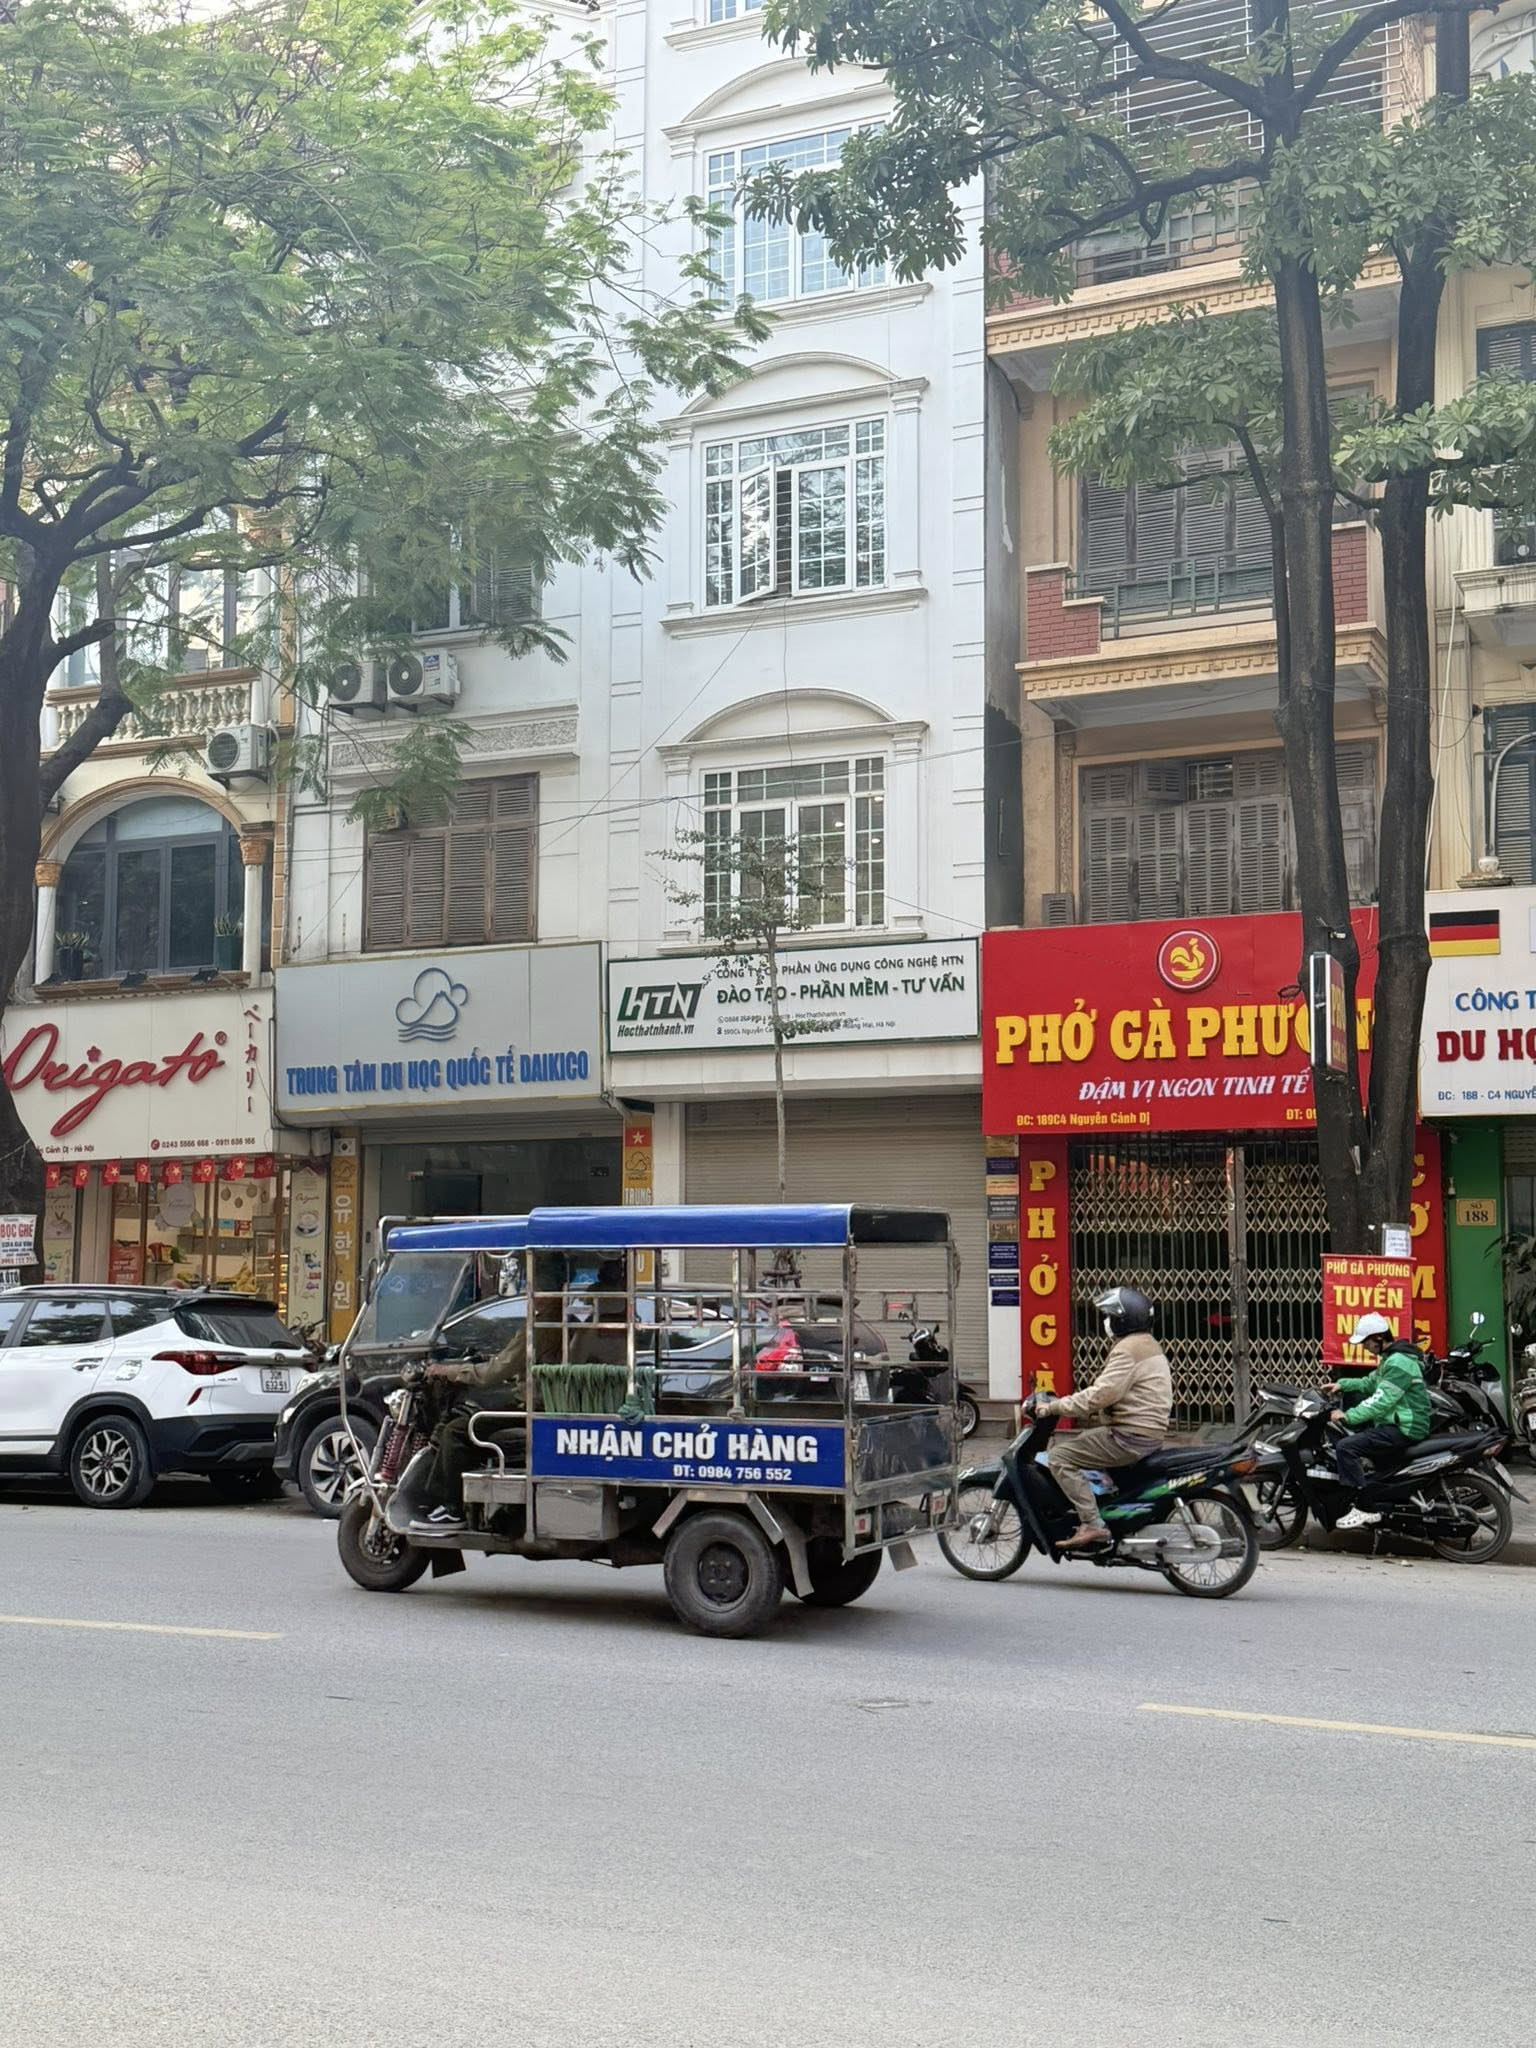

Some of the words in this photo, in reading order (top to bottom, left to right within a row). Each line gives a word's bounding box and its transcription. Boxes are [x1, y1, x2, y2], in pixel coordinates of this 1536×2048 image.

[717, 967, 745, 978] CÔNG
[782, 961, 811, 975] PHẦN
[814, 960, 837, 973] ỨNG
[840, 959, 871, 972] DỤNG
[874, 957, 904, 970] CÔNG
[907, 955, 938, 969] NGHỆ
[941, 955, 964, 966] HTN
[717, 984, 752, 1004] ĐÀO
[754, 986, 787, 1004] TẠO
[800, 979, 845, 999] PHẦN
[849, 976, 889, 997] MỀM
[901, 977, 926, 994] TƯ
[930, 972, 965, 992] VẤN
[1455, 987, 1519, 1012] CÔNG
[617, 1023, 694, 1037] Hocthatnhanh.vn
[995, 998, 1098, 1064] PHỞ
[1109, 998, 1176, 1060] GÀ
[1437, 1030, 1486, 1062] DU
[4, 1023, 225, 1137] Origato
[286, 1066, 338, 1095] TRUNG
[343, 1059, 376, 1092] TÂM
[381, 1061, 403, 1090] DU
[408, 1059, 441, 1092] HỌC
[446, 1047, 491, 1090] QUỐC
[496, 1044, 515, 1084] TẾ
[520, 1050, 588, 1082] DAIKICO
[1079, 1077, 1128, 1105] ĐẬM
[1132, 1078, 1154, 1103] VỊ
[1158, 1077, 1219, 1098] NGON
[1223, 1074, 1276, 1096] TINH
[1281, 1067, 1311, 1094] TẾ
[1438, 1090, 1455, 1101] ĐC:
[1461, 1090, 1478, 1100] 188
[1488, 1089, 1501, 1100] C4
[1016, 1114, 1034, 1126] ĐC:
[1070, 1112, 1107, 1126] Nguyễn
[1110, 1112, 1136, 1124] Cảnh
[1139, 1112, 1150, 1125] Dị
[1286, 1108, 1303, 1120] ĐT:
[624, 1187, 652, 1205] TRUNG
[1027, 1160, 1058, 1296] PHỞ
[1464, 1210, 1489, 1223] 188
[1326, 1259, 1347, 1274] PHỞ
[1350, 1259, 1364, 1275] GÀ
[1367, 1261, 1410, 1277] PHƯƠNG
[1333, 1279, 1403, 1309] TUYỂN
[1336, 1313, 1400, 1338] NN
[556, 1424, 643, 1462] NHẬN
[652, 1423, 718, 1460] CHỞ
[728, 1428, 818, 1463] HÀNG
[673, 1464, 695, 1478] ĐT:
[698, 1465, 732, 1479] 0984
[736, 1467, 761, 1480] 756
[765, 1468, 792, 1481] 552
